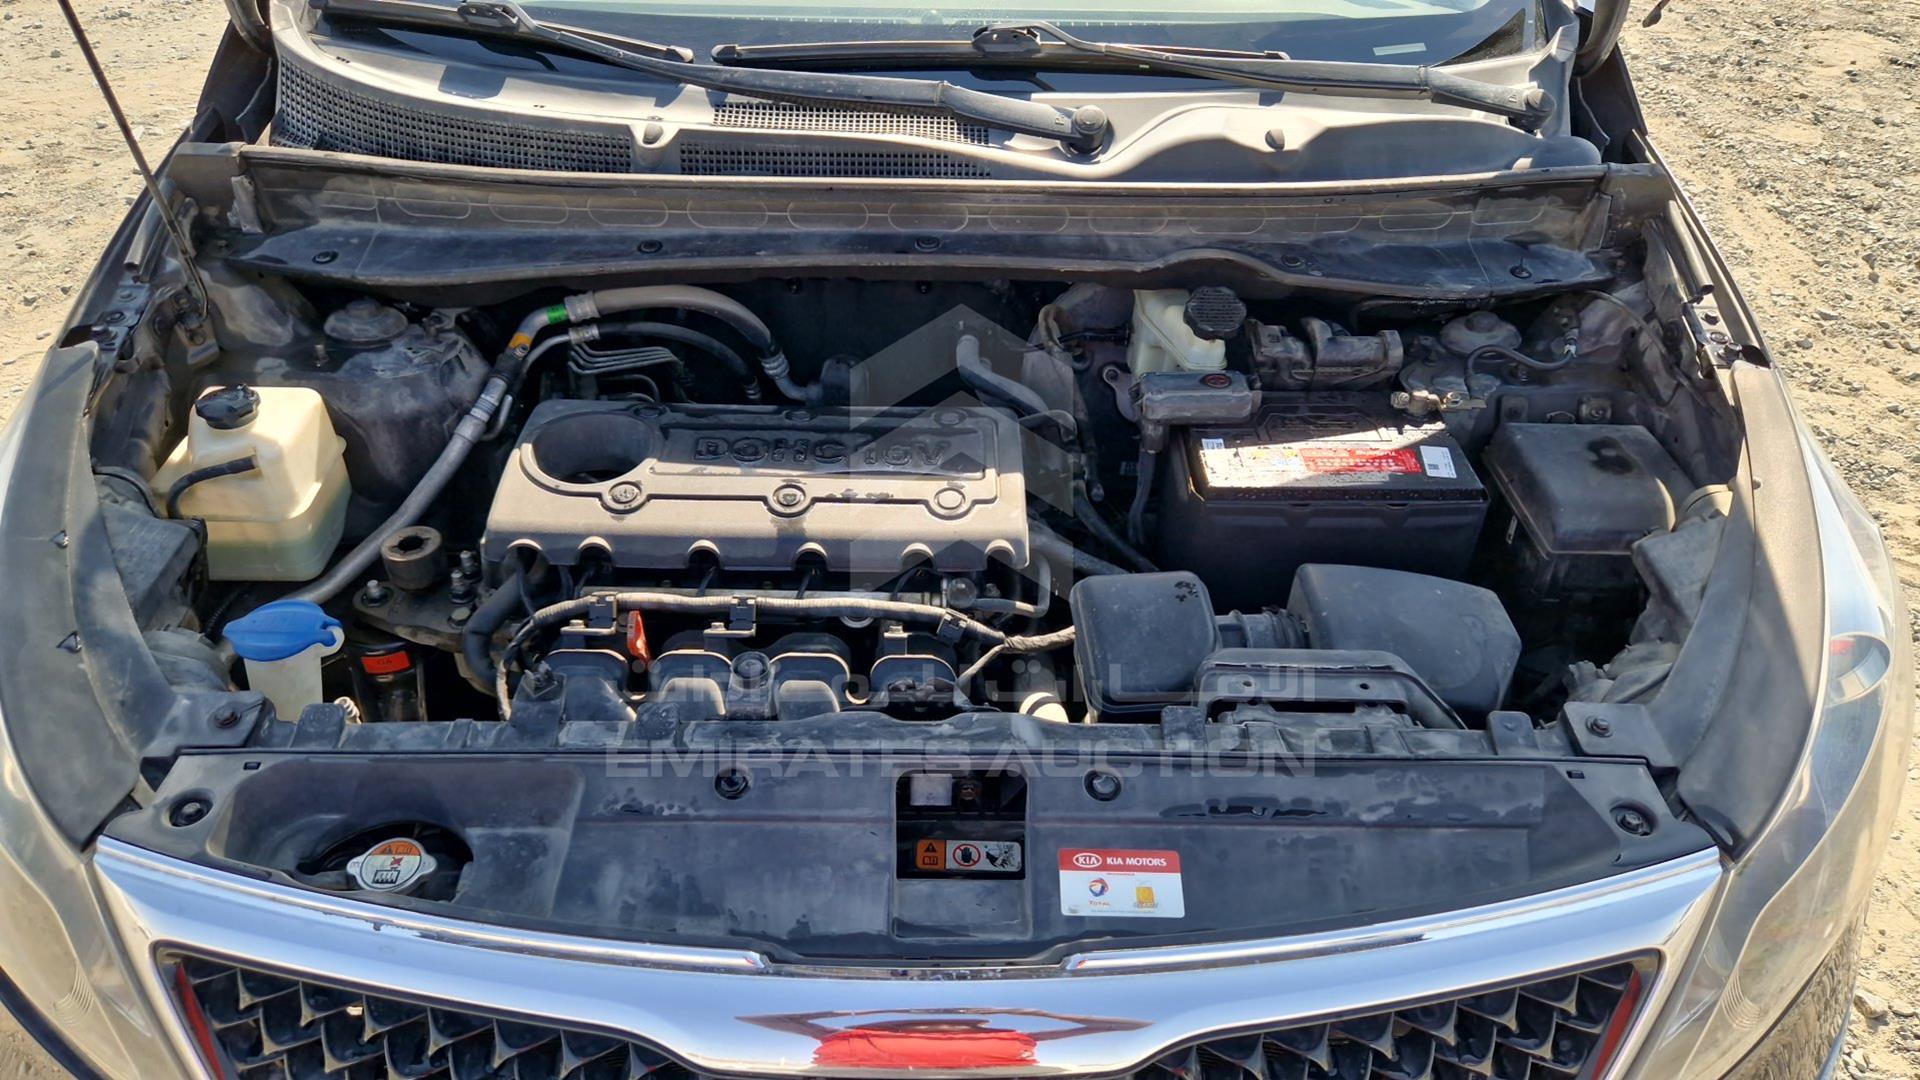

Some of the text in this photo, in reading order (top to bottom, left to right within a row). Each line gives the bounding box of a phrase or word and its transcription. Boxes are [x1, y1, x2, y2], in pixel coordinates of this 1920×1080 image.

[693, 437, 849, 464] DOHC
[1077, 856, 1098, 865] KIA
[1106, 857, 1168, 867] KIA MOTORS
